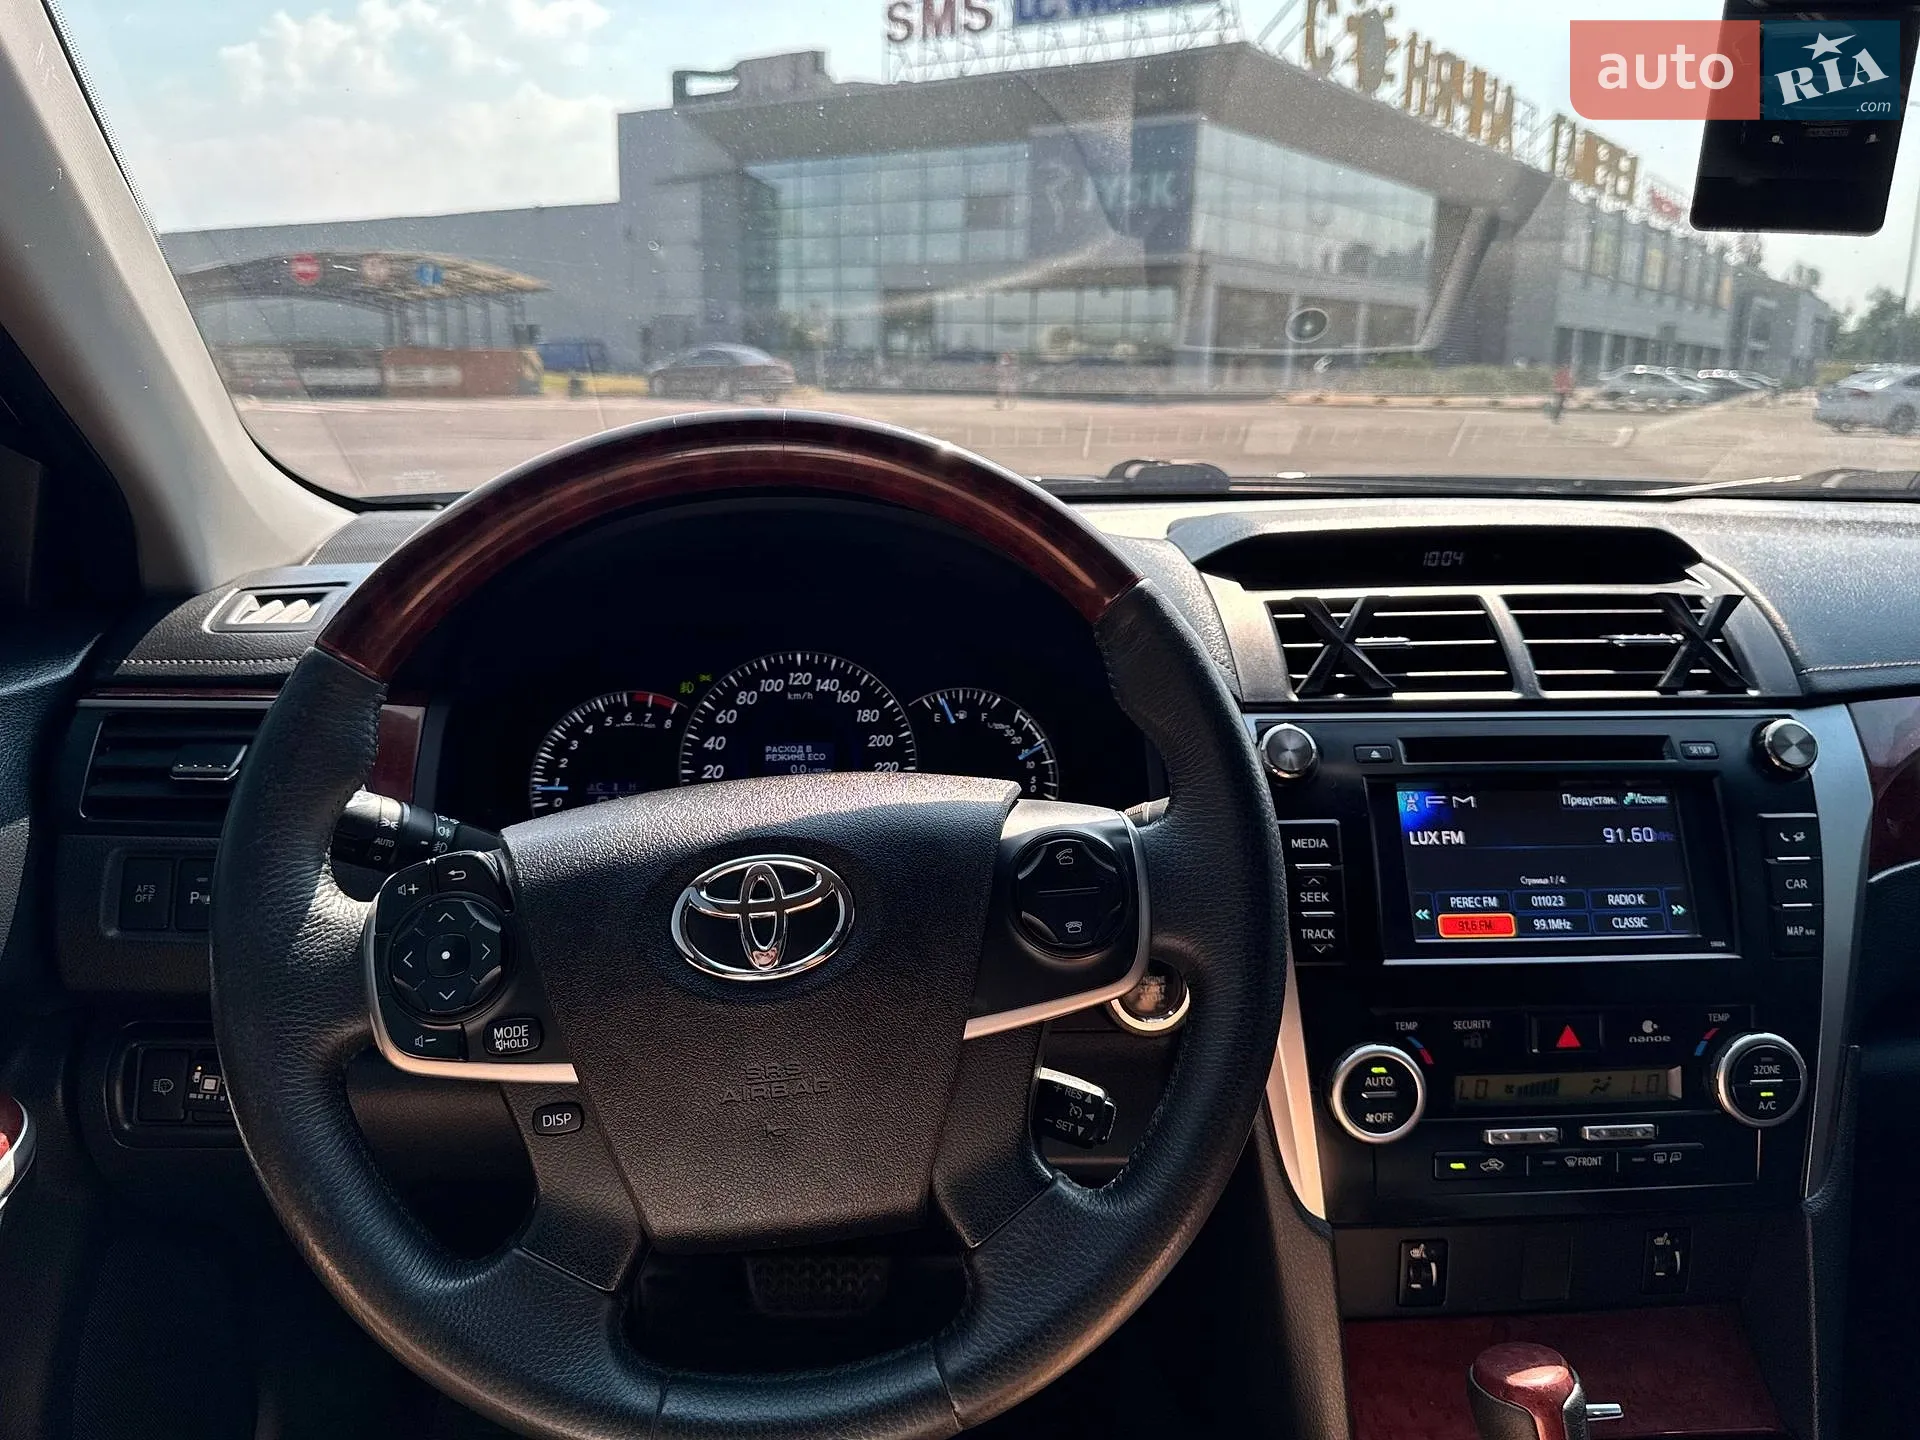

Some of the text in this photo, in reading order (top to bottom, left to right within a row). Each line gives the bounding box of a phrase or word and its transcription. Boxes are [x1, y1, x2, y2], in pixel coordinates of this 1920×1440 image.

[788, 672, 812, 686] 120
[759, 679, 784, 692] 100
[816, 678, 839, 692] 140
[736, 691, 757, 705] 80
[787, 692, 813, 701] km/h
[836, 690, 860, 703] 160
[604, 716, 613, 726] 5
[624, 712, 632, 722] 6
[644, 713, 652, 723] 7
[715, 709, 737, 723] 60
[856, 709, 880, 723] 180
[934, 713, 940, 722] E
[981, 713, 988, 722] F
[584, 725, 594, 734] 4
[664, 719, 672, 729] 8
[568, 740, 579, 750] 3
[703, 736, 726, 750] 40
[868, 734, 893, 747] 200
[1011, 736, 1022, 745] 20
[765, 746, 804, 754] РАСХОД
[558, 758, 568, 768] 2
[874, 761, 899, 773] 220
[1026, 761, 1035, 769] 10
[701, 764, 724, 779] 20
[554, 797, 562, 808] 0
[1562, 793, 1617, 807] Предустан.
[1409, 831, 1466, 845] LUX FM
[1603, 827, 1654, 843] 91.60
[373, 837, 395, 848] AUTO
[1291, 838, 1329, 849] MEDIA
[136, 884, 155, 894] AFS
[1785, 879, 1808, 889] CAR
[135, 894, 154, 903] OFF
[1300, 892, 1330, 902] SEEK
[1450, 896, 1499, 908] PEREC FM
[1607, 894, 1647, 905] RADIO K
[1612, 917, 1648, 928] CLASSIC
[1301, 928, 1335, 939] TRACK
[1786, 925, 1804, 936] MAP
[1708, 1013, 1730, 1022] TEMP
[1395, 1021, 1418, 1030] TEMP
[1453, 1020, 1491, 1030] SECURITY
[493, 1025, 529, 1039] MODE
[502, 1038, 529, 1049] HOLD
[1629, 1035, 1671, 1043] nanoe
[1754, 1065, 1780, 1074] 3ZONE
[1365, 1076, 1394, 1087] AUTO
[1064, 1086, 1084, 1100] RES
[1758, 1101, 1776, 1111] A/C
[542, 1113, 572, 1126] DISP
[1374, 1112, 1394, 1123] OFF
[1056, 1119, 1074, 1132] SET
[1578, 1156, 1602, 1167] FRONT
